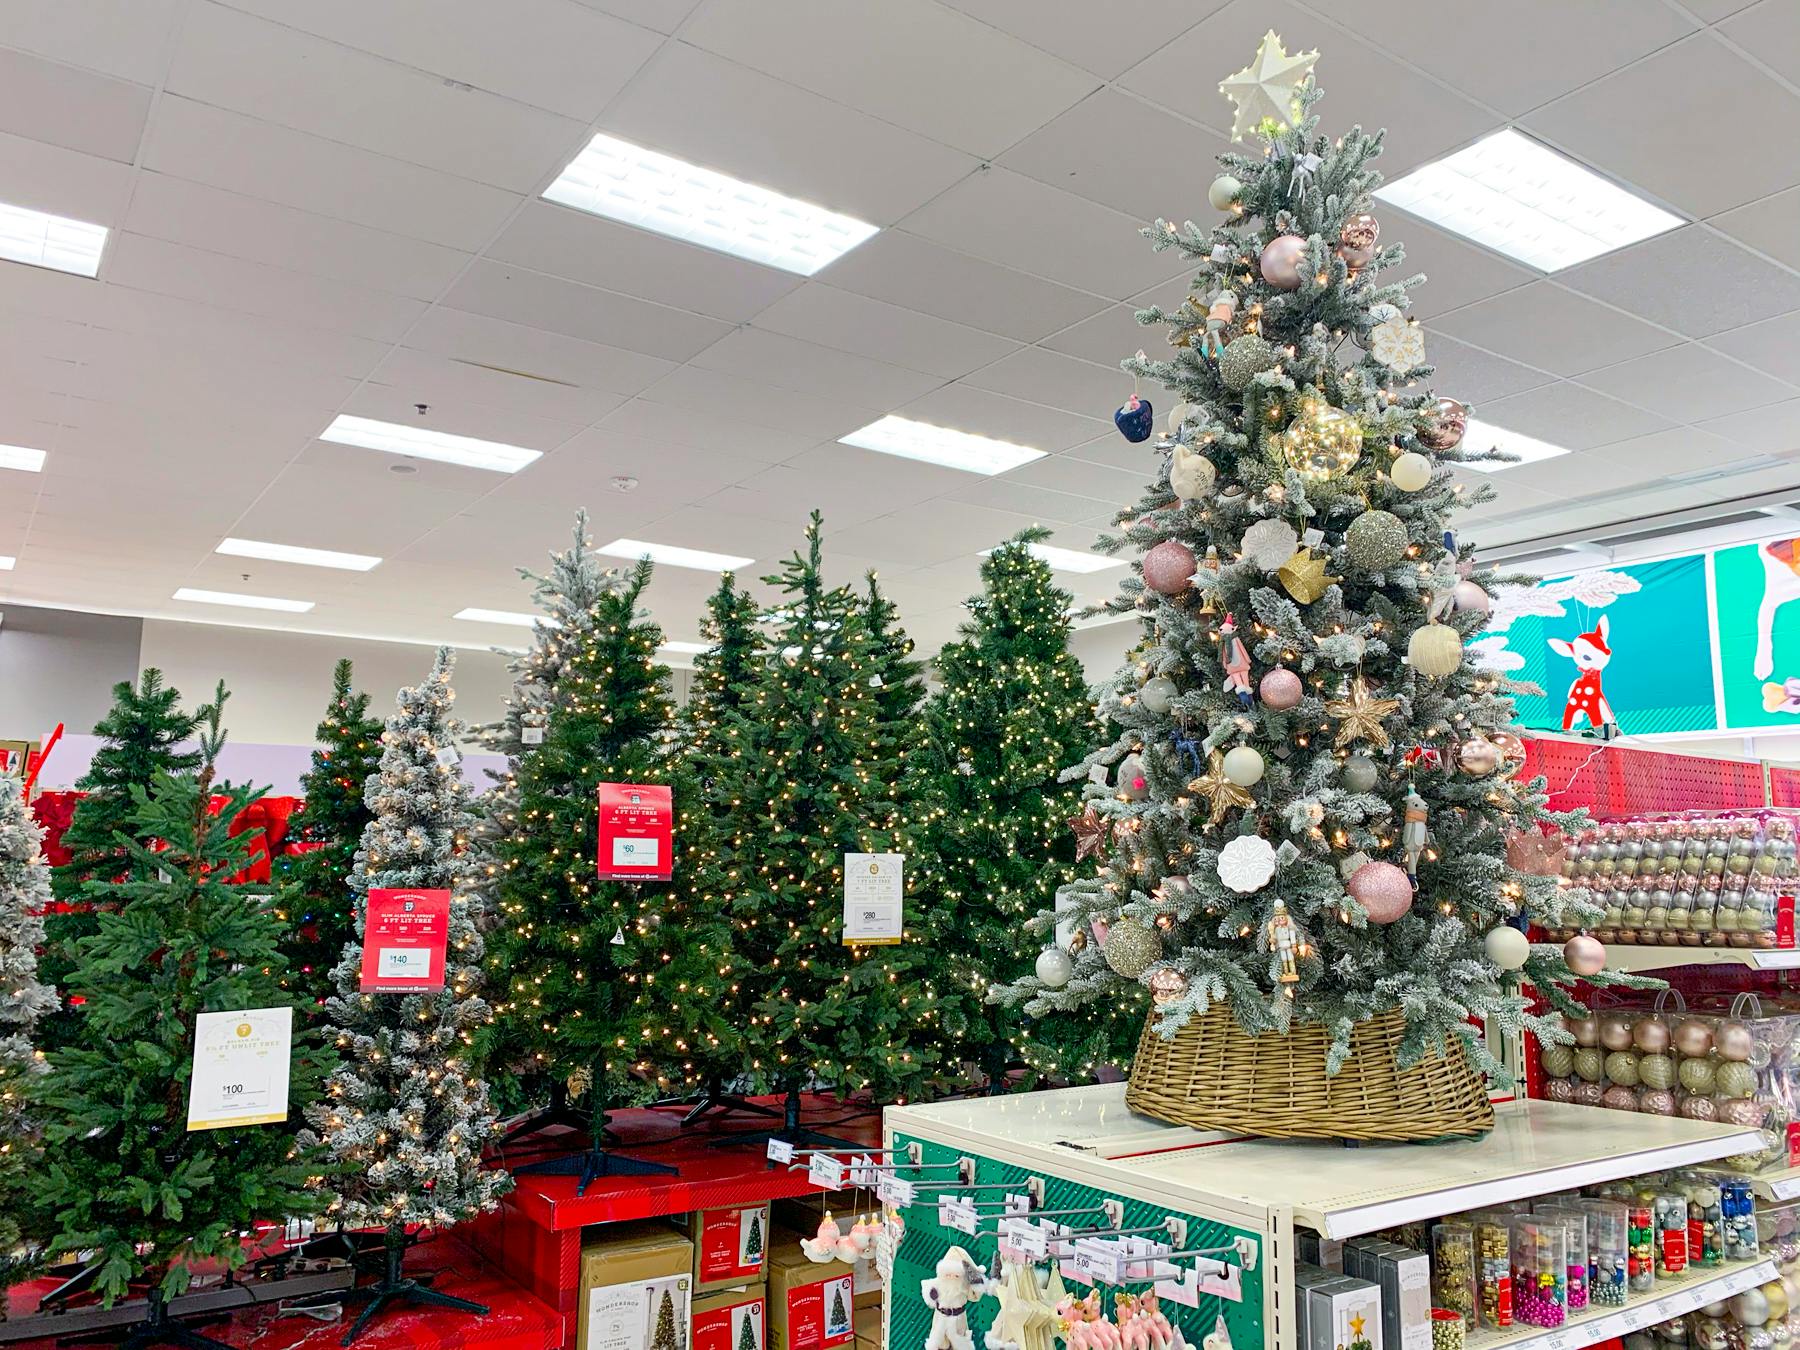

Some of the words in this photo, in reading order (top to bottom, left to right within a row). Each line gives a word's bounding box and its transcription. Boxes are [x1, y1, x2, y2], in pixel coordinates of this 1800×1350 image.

[390, 955, 408, 964] $140
[222, 1084, 243, 1094] $100
[1011, 1236, 1022, 1246] 5.00
[1076, 1258, 1090, 1268] 5.00
[596, 1301, 639, 1313] WONDERSHOP
